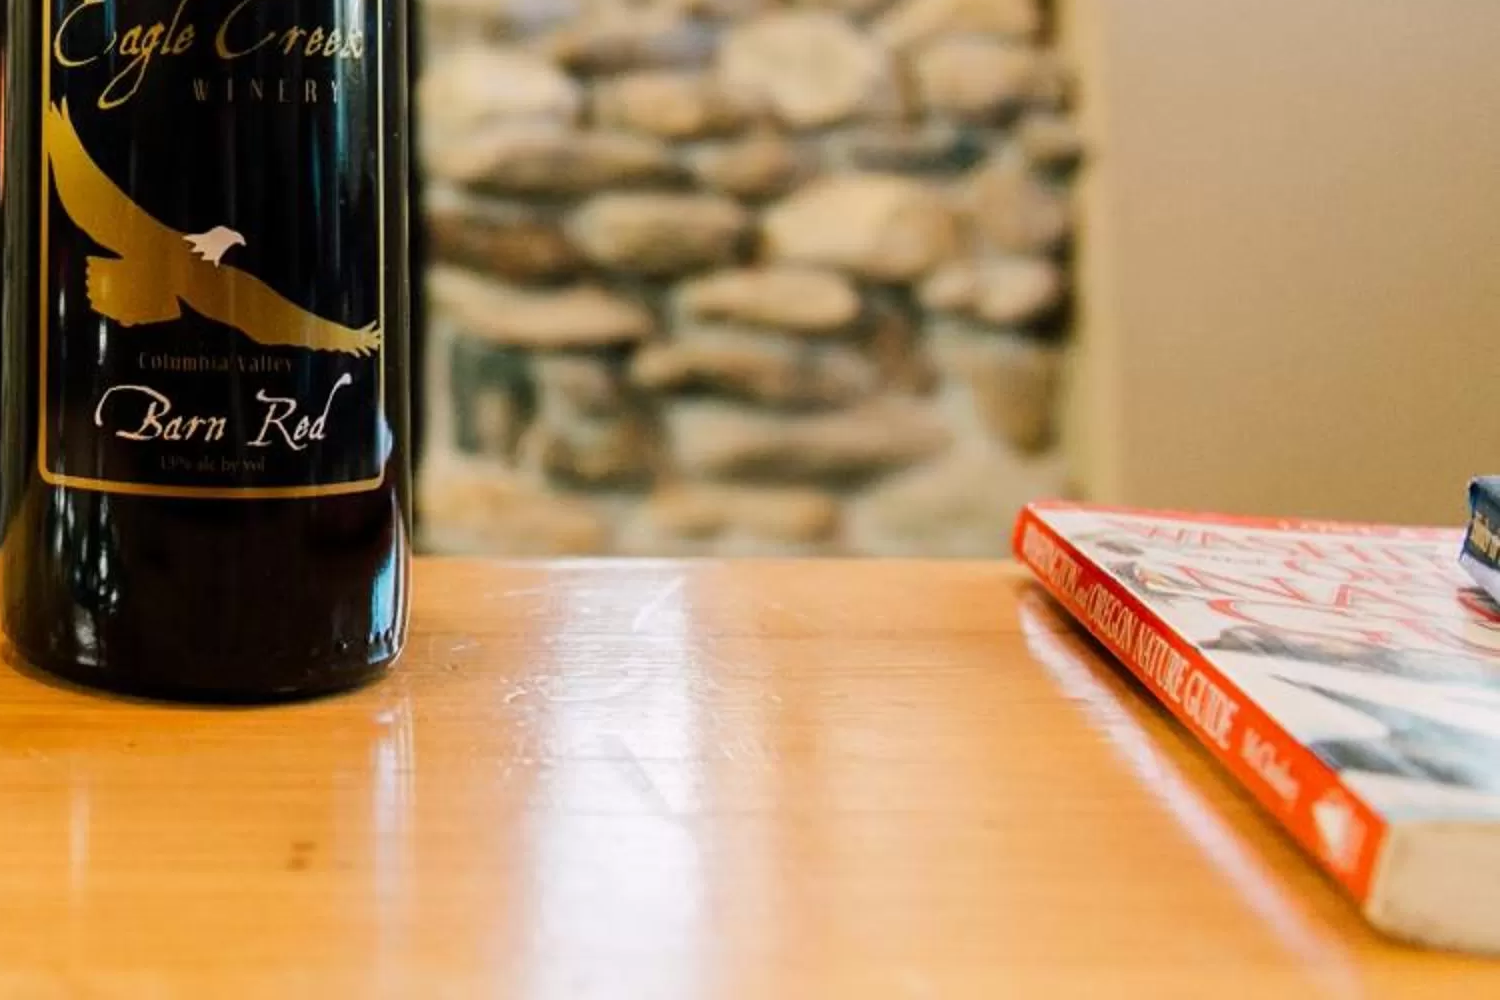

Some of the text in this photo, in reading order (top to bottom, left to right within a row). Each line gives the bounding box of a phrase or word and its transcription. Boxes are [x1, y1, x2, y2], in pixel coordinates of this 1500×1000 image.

[192, 76, 342, 103] WINERY
[138, 351, 292, 374] Columbia Valley
[95, 373, 352, 451] Barn Red
[1086, 584, 1138, 654] OREGON
[1131, 621, 1190, 704] NATURE
[1183, 669, 1241, 750] GUIDE
